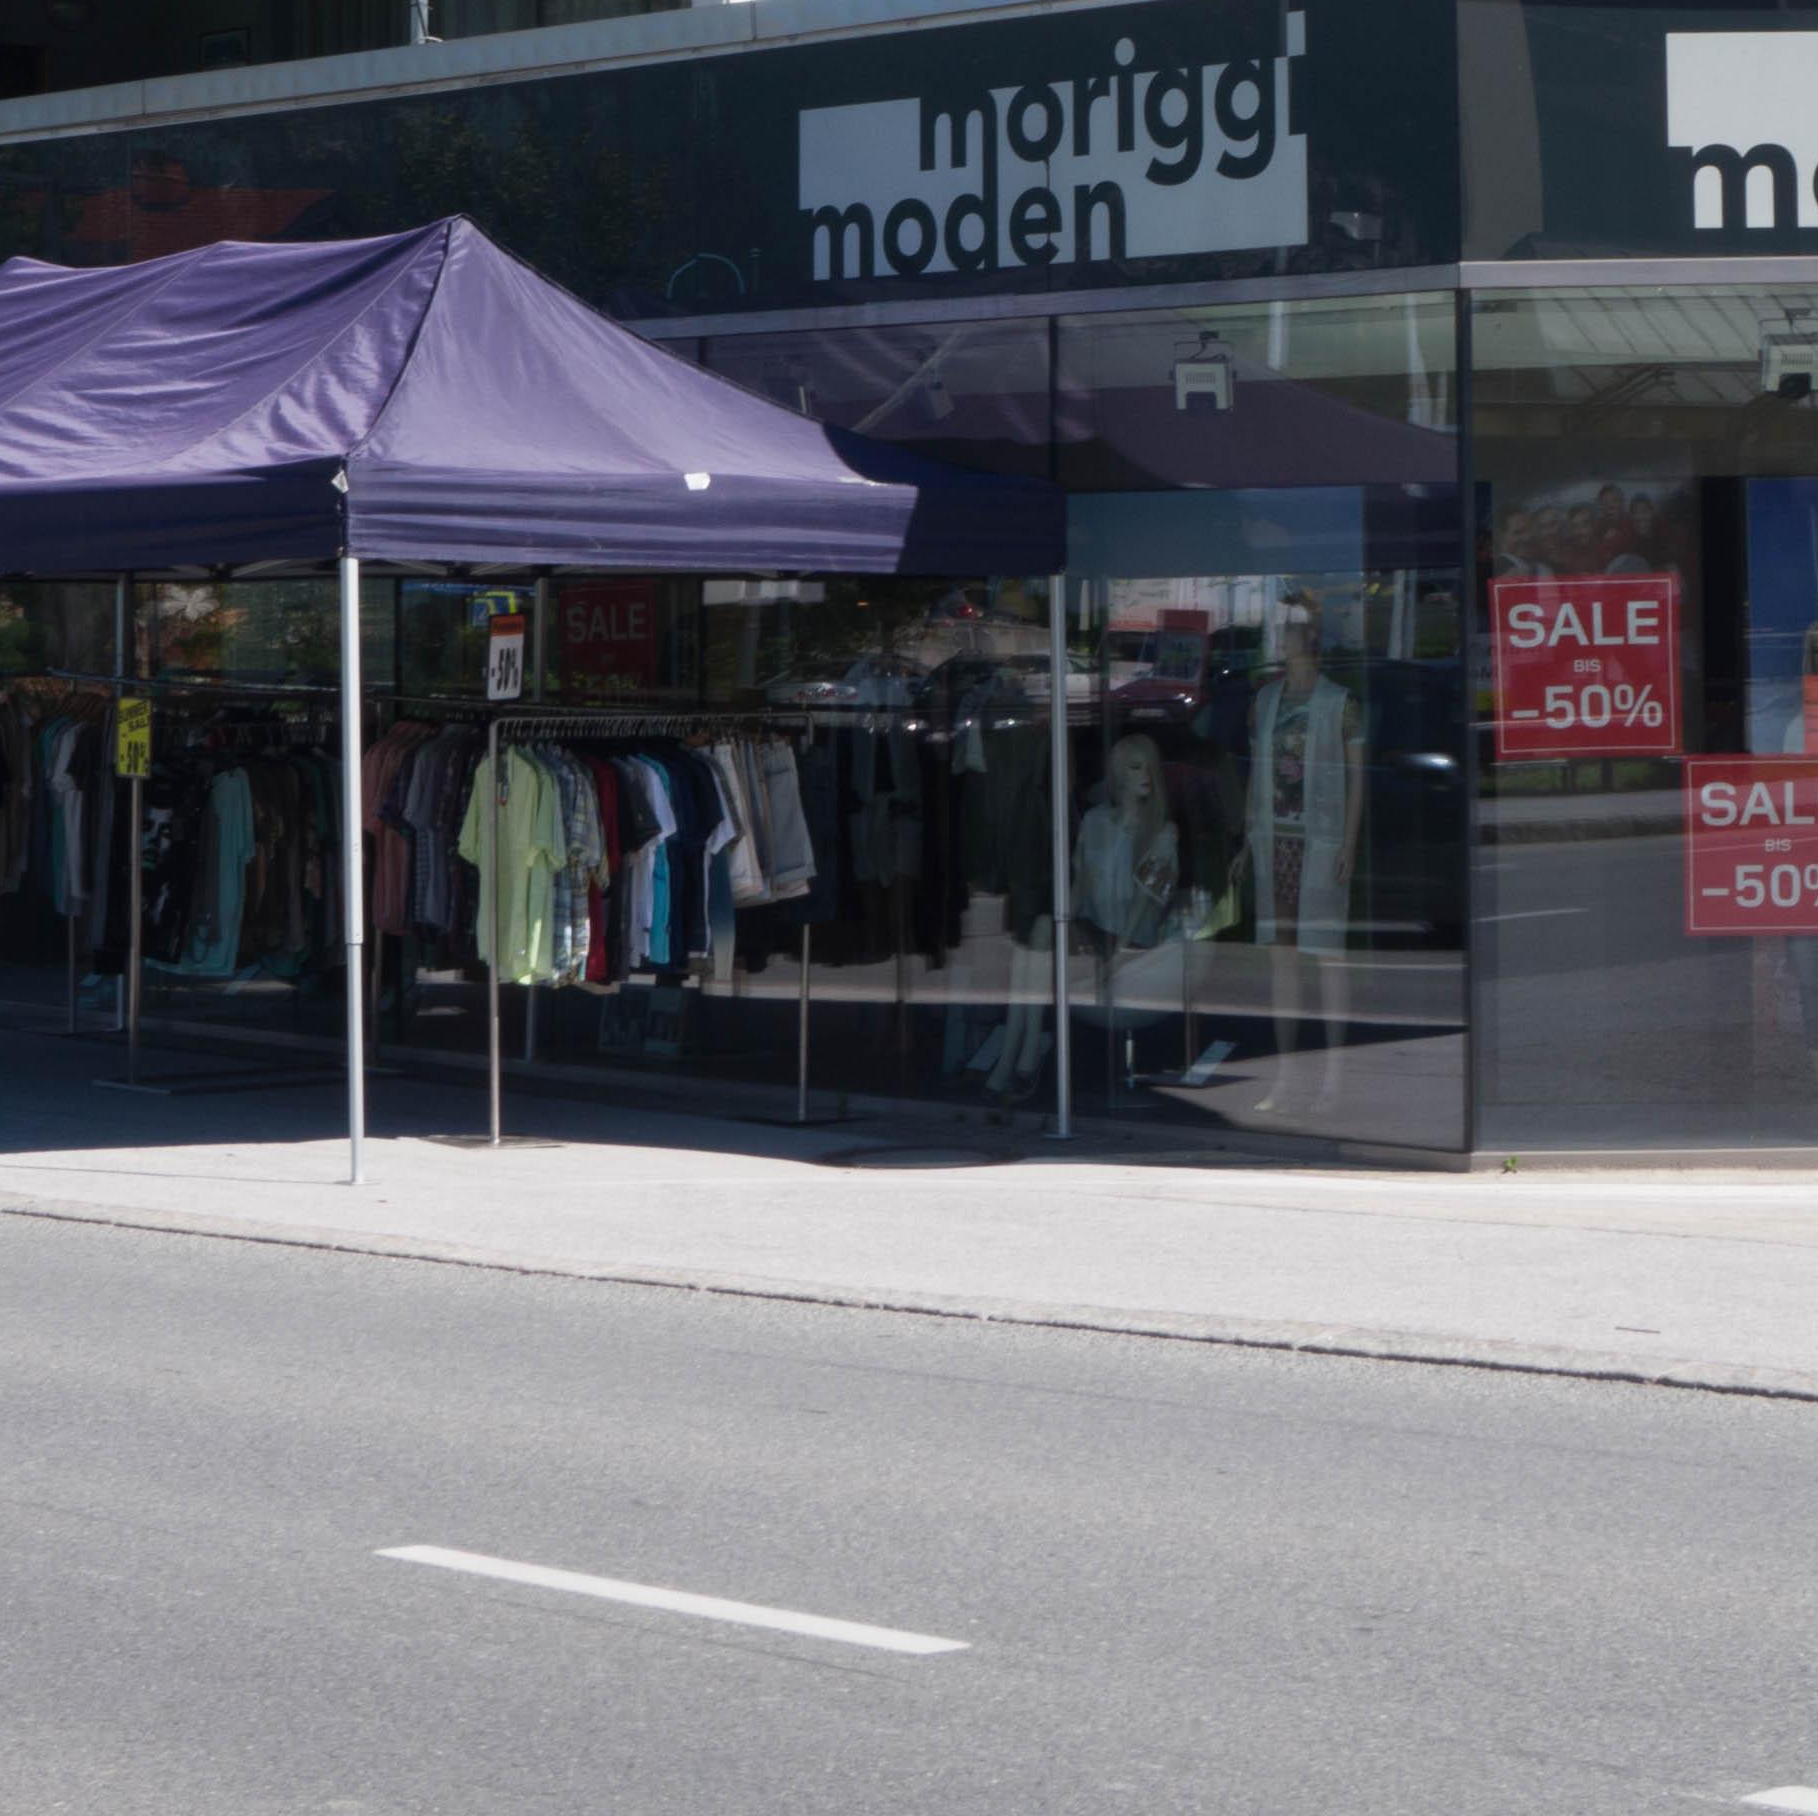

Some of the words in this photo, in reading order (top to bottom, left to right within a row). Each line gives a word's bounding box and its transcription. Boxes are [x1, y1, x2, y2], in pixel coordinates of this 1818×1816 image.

[799, 159, 1127, 281] moden
[565, 601, 647, 644] SALE
[1508, 600, 1660, 649] SALE
[1573, 659, 1602, 673] BIS
[1512, 684, 1663, 729] -50%
[1764, 839, 1792, 853] BIS
